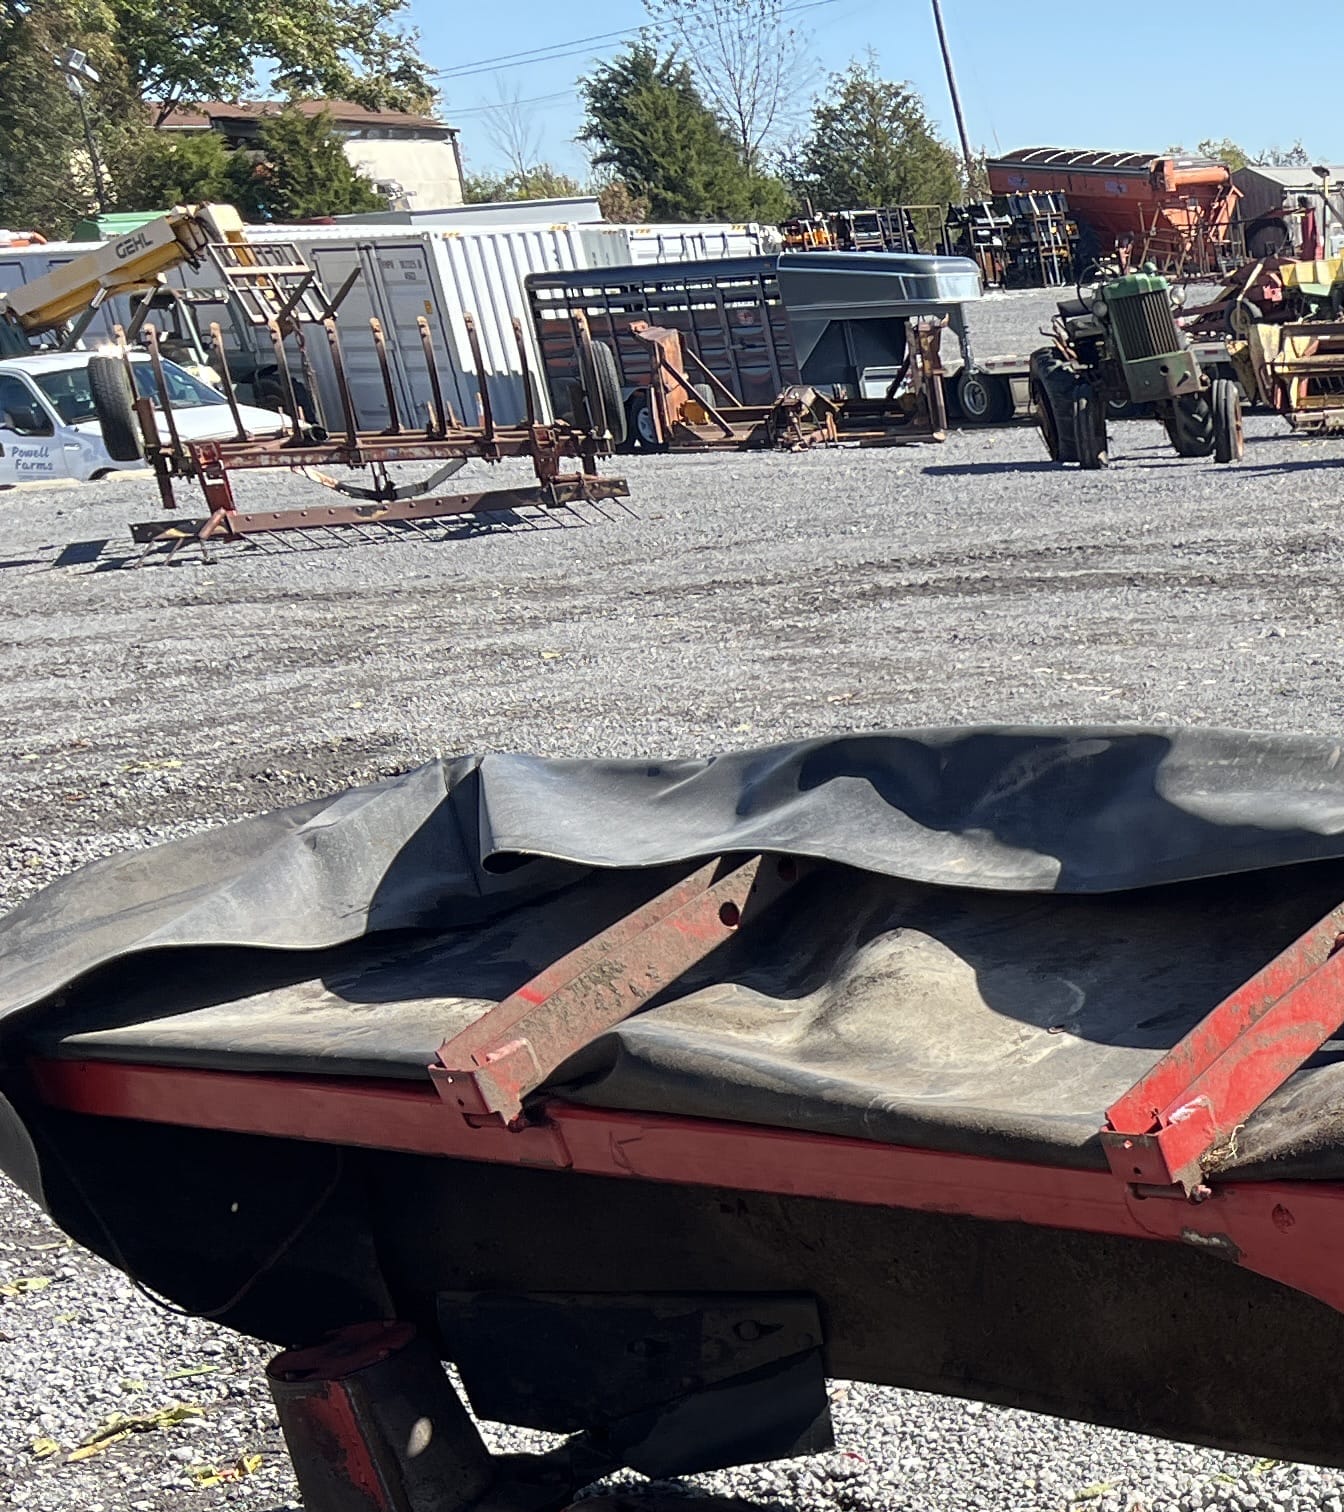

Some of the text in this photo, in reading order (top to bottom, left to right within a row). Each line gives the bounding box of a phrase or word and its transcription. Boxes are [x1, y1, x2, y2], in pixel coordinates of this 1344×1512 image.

[116, 232, 153, 259] GEHL
[11, 446, 50, 458] Powell
[15, 458, 53, 471] Farms
